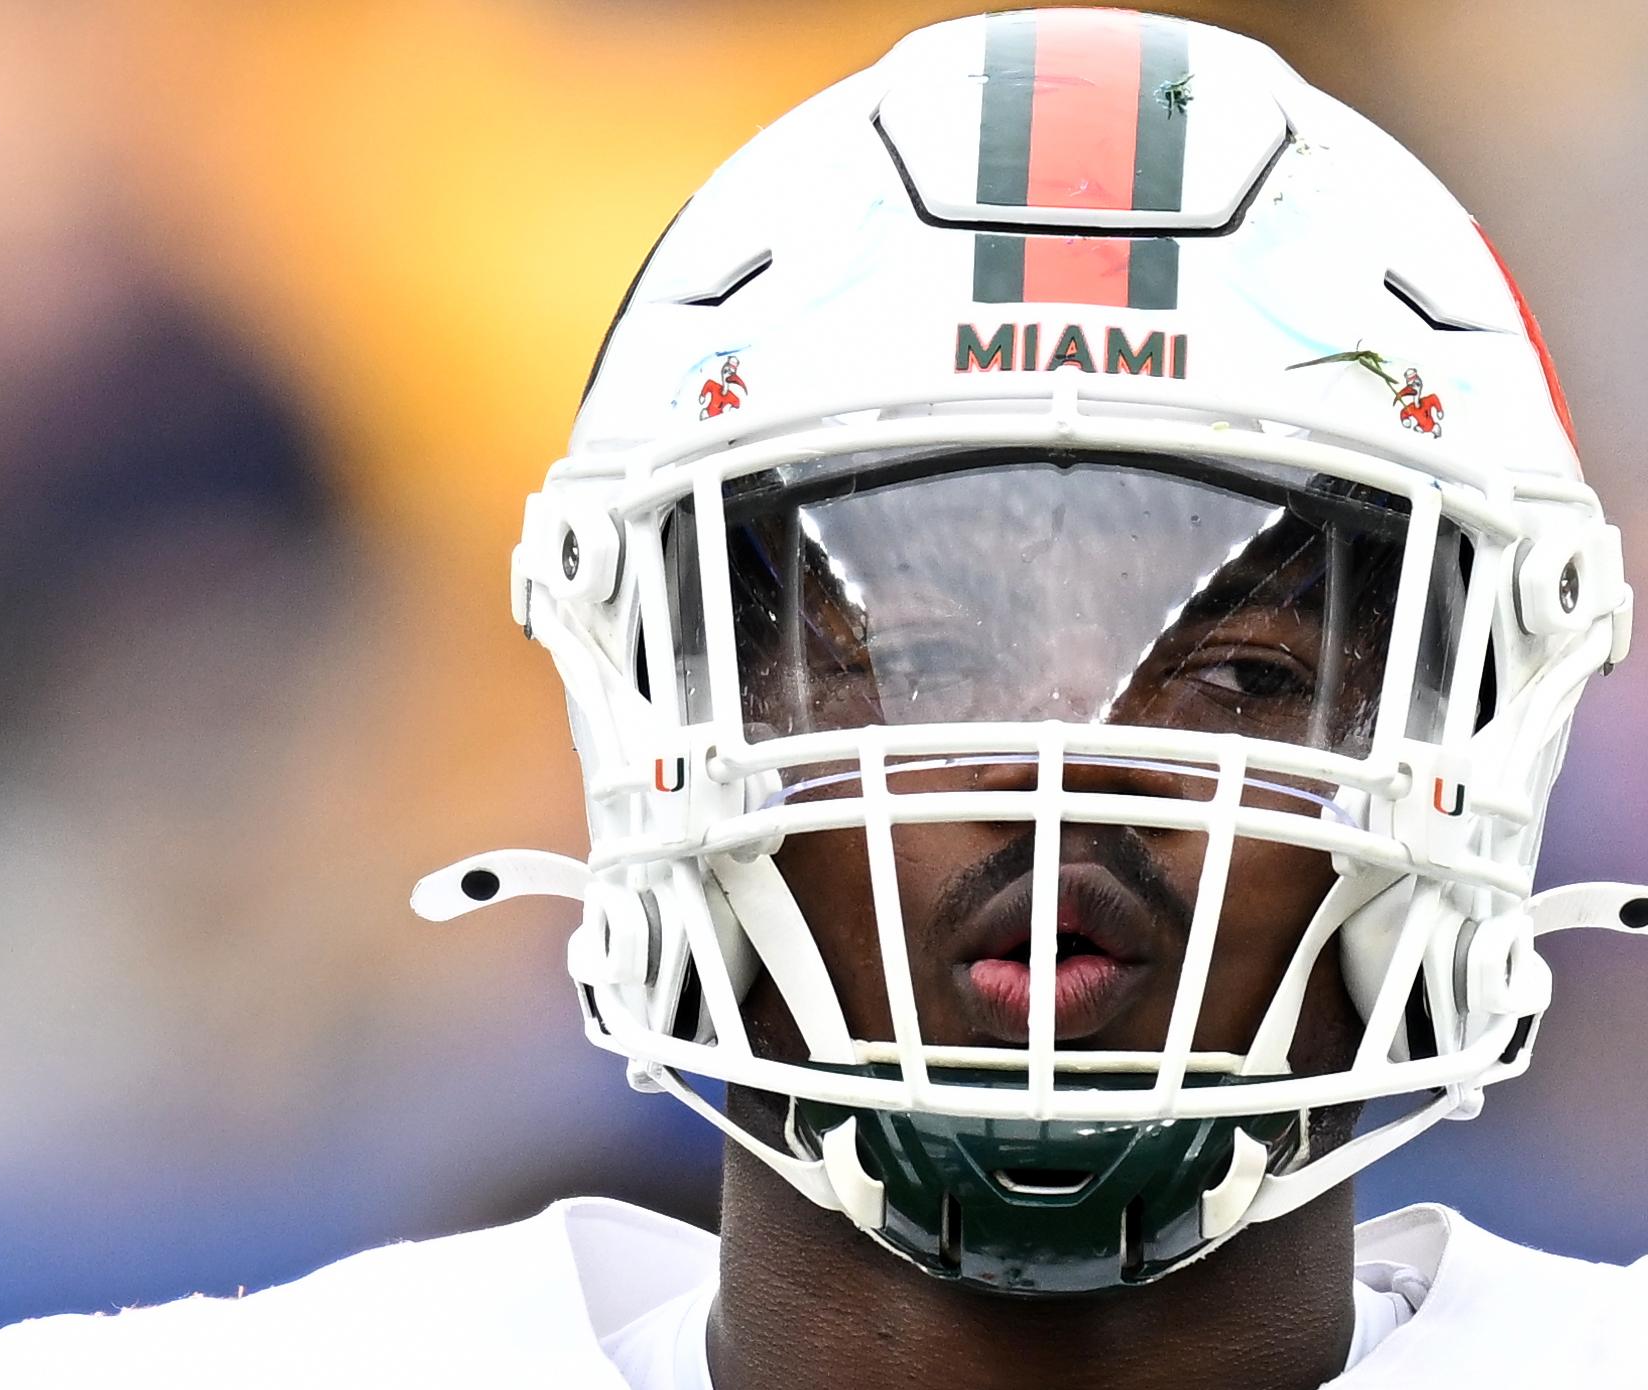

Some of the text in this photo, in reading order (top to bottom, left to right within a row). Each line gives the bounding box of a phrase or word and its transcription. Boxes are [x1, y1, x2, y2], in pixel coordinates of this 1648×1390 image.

[954, 322, 1188, 379] MIAMI
[655, 757, 685, 792] U
[1433, 776, 1465, 816] U
